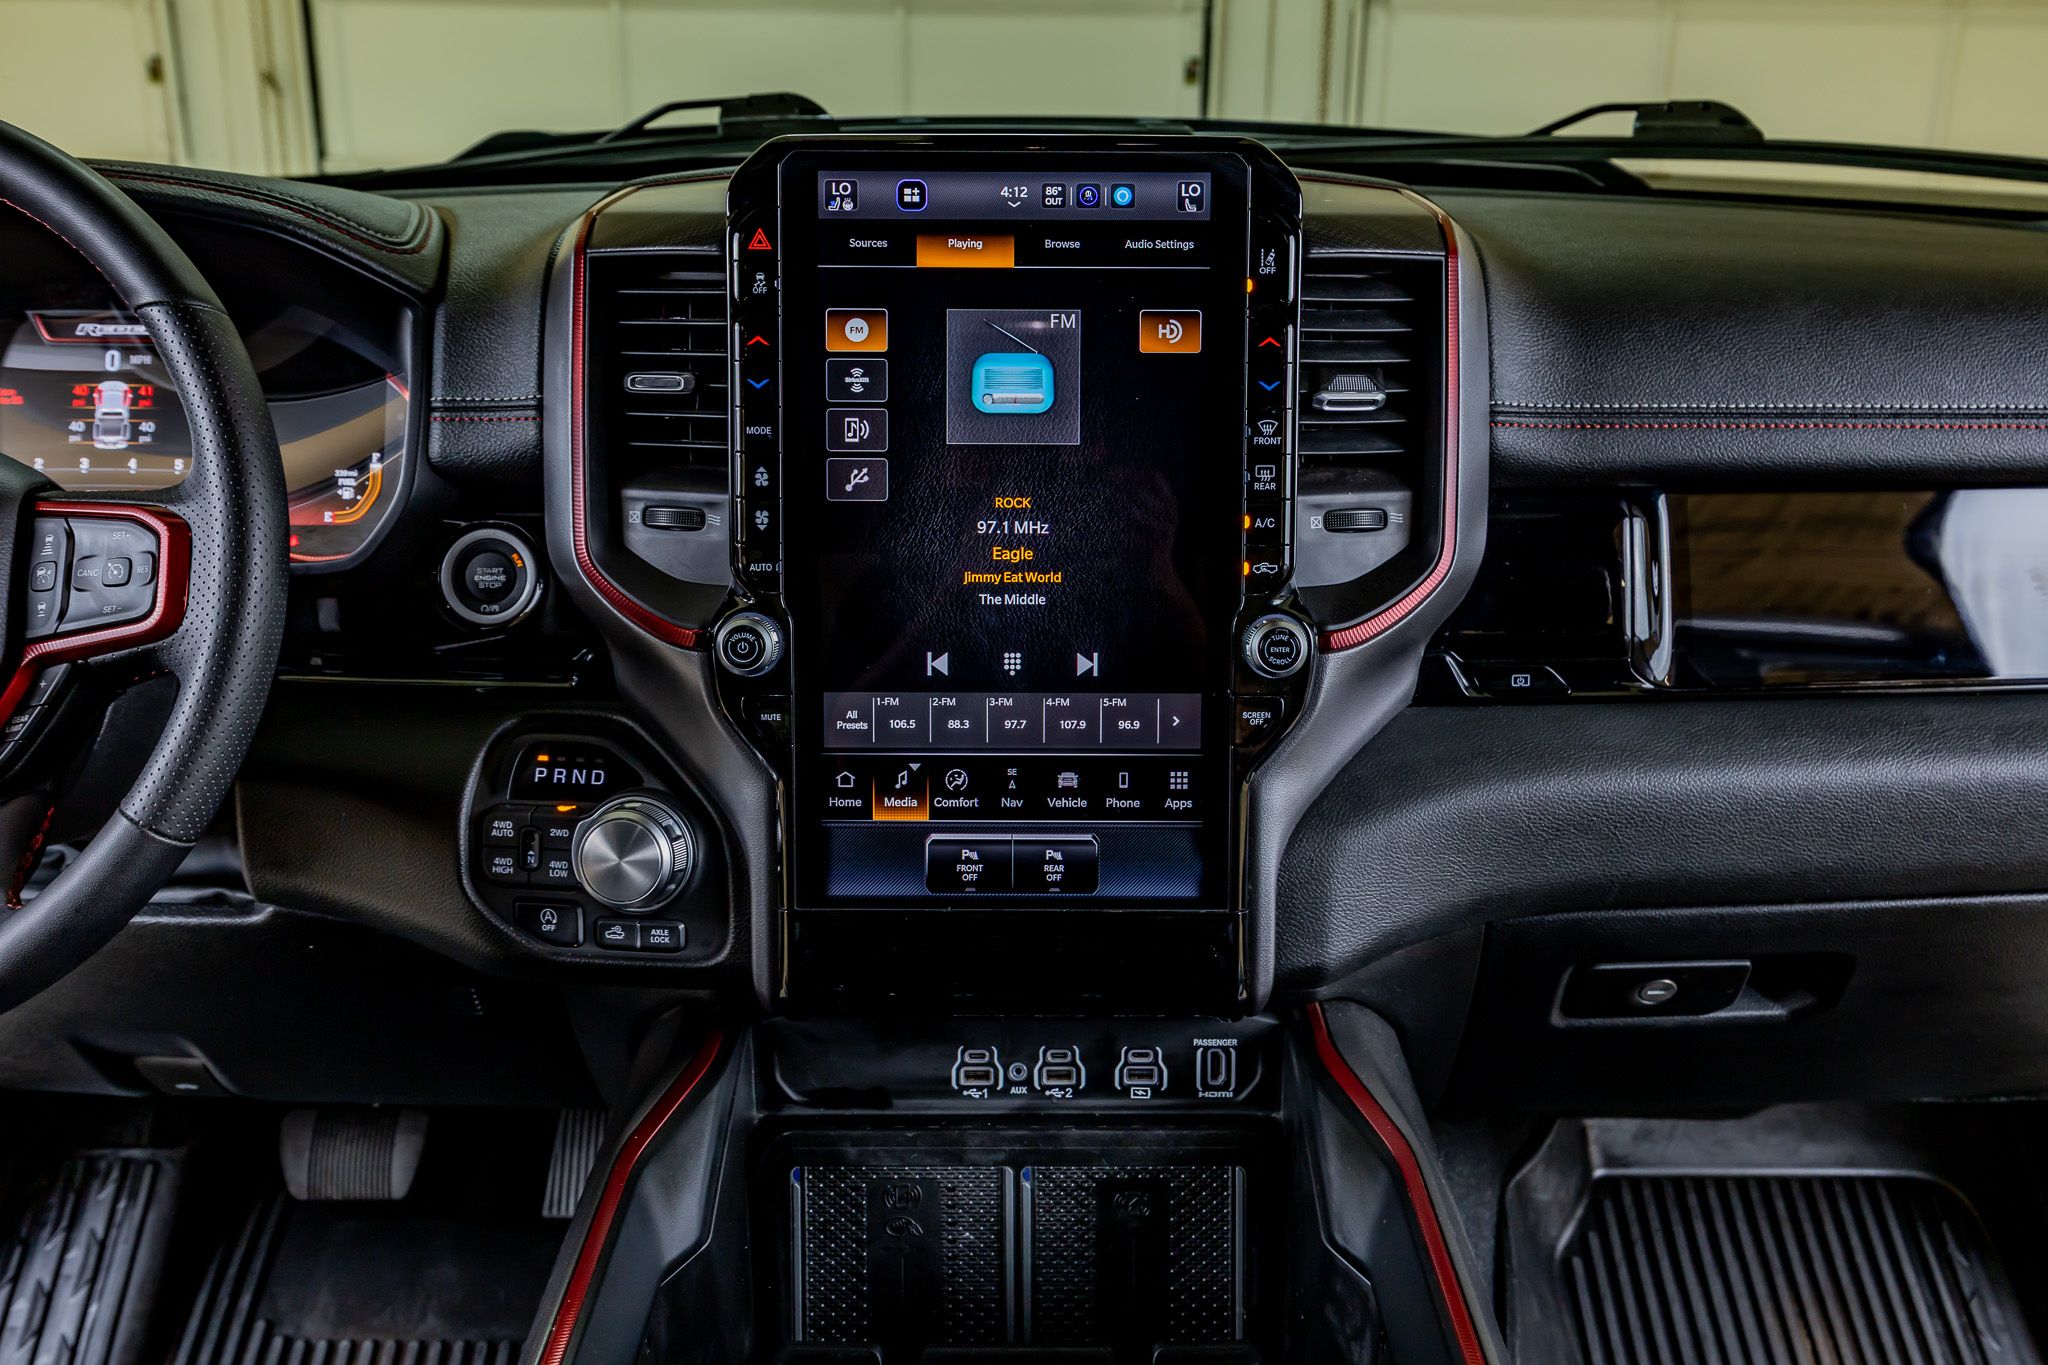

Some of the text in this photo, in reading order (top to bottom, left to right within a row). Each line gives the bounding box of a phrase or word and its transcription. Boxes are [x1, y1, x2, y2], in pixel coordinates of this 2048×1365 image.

[831, 182, 852, 196] LO
[1000, 186, 1028, 198] 4:12
[1181, 183, 1201, 197] LO
[1044, 197, 1064, 206] OUT
[849, 238, 888, 248] Sources
[947, 238, 984, 251] Playing
[1044, 239, 1081, 249] Browse
[1124, 239, 1195, 251] Audio Settings
[1258, 264, 1277, 275] OFF
[752, 284, 768, 294] OFF
[1050, 313, 1077, 330] FM
[849, 326, 864, 335] FM
[105, 349, 153, 372] 0 MPH
[72, 385, 89, 397] 40
[138, 386, 154, 397] 41
[68, 421, 87, 433] 40
[138, 421, 156, 433] 40
[746, 426, 772, 435] MODE
[1253, 436, 1282, 445] FRONT
[79, 457, 91, 469] 3
[127, 457, 138, 469] 4
[173, 458, 185, 470] 5
[1253, 482, 1276, 491] REAR
[995, 497, 1032, 509] ROCK
[977, 520, 1050, 535] 97.1 MHz
[1254, 517, 1276, 529] A/C
[992, 546, 1034, 564] Eagle
[137, 565, 149, 574] RES
[475, 567, 505, 575] START
[749, 563, 773, 572] AUTO
[77, 568, 99, 578] CANC
[963, 571, 1062, 585] Jimmy Eat World
[978, 593, 1046, 606] The Middle
[729, 631, 757, 643] VOLUME
[1270, 634, 1290, 642] TUNE
[1268, 655, 1292, 666] SCROLL
[932, 697, 956, 706] 2-FM
[989, 697, 1013, 707] 3-FM
[1045, 697, 1070, 707] 4-FM
[1103, 697, 1127, 707] 5-FM
[760, 713, 782, 721] MUTE
[845, 709, 858, 719] All
[1242, 711, 1271, 719] SCREEN
[836, 720, 869, 730] Presets
[889, 719, 916, 729] 106.5
[947, 719, 970, 729] 88.3
[1004, 719, 1027, 729] 97.7
[1059, 720, 1087, 730] 107.9
[1118, 720, 1141, 730] 96.9
[1249, 718, 1264, 726] OFF
[1007, 768, 1018, 776] SE
[829, 796, 863, 807] Home
[883, 796, 919, 808] Media
[933, 796, 980, 808] Comfort
[1001, 797, 1024, 808] Nav
[1047, 797, 1088, 808] Vehicle
[1105, 797, 1141, 808] Phone
[1164, 797, 1193, 811] Apps
[492, 820, 513, 831] 4WD
[491, 828, 514, 838] AUTO
[549, 828, 570, 837] 2WD
[493, 857, 513, 866] 4WD
[548, 860, 569, 869] 4WD
[492, 865, 514, 874] HIGH
[956, 864, 984, 872] FRONT
[1043, 864, 1065, 873] REAR
[549, 869, 569, 878] LOW
[961, 873, 978, 882] OFF
[1046, 873, 1062, 882] OFF
[541, 921, 557, 932] OFF
[650, 928, 670, 938] AXLE
[650, 935, 670, 944] LOCK
[1193, 1038, 1238, 1047] PASSENGER
[1009, 1086, 1028, 1095] AUX
[1064, 1087, 1073, 1098] 2
